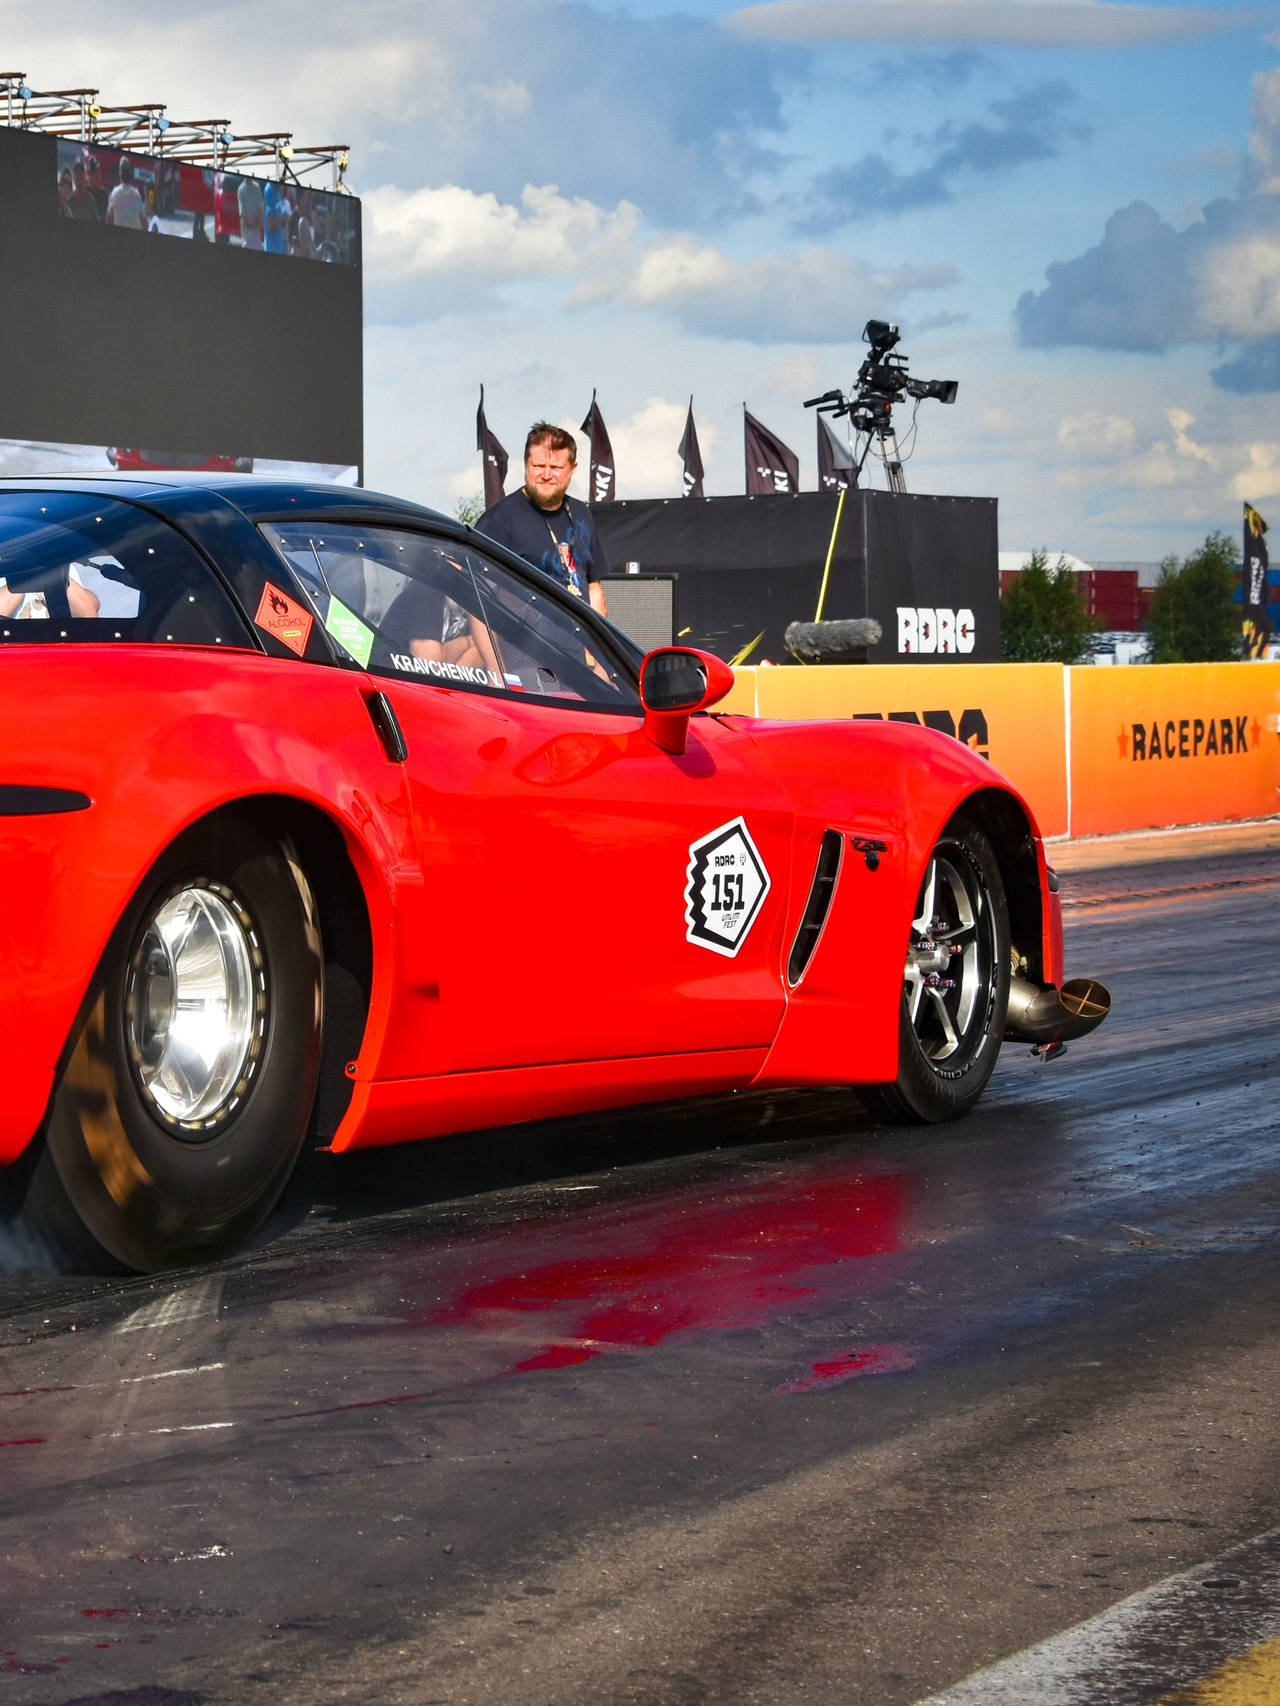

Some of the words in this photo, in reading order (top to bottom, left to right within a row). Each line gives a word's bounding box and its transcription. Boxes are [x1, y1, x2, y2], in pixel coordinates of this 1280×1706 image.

[268, 617, 307, 628] ALCOHOL
[896, 607, 975, 654] RDRC
[389, 653, 489, 685] KRAVCHENKO
[487, 670, 503, 688] V.
[1131, 715, 1249, 761] RACEPARK
[714, 854, 735, 867] RDRC
[710, 873, 745, 911] 151
[723, 920, 737, 929] FEST
